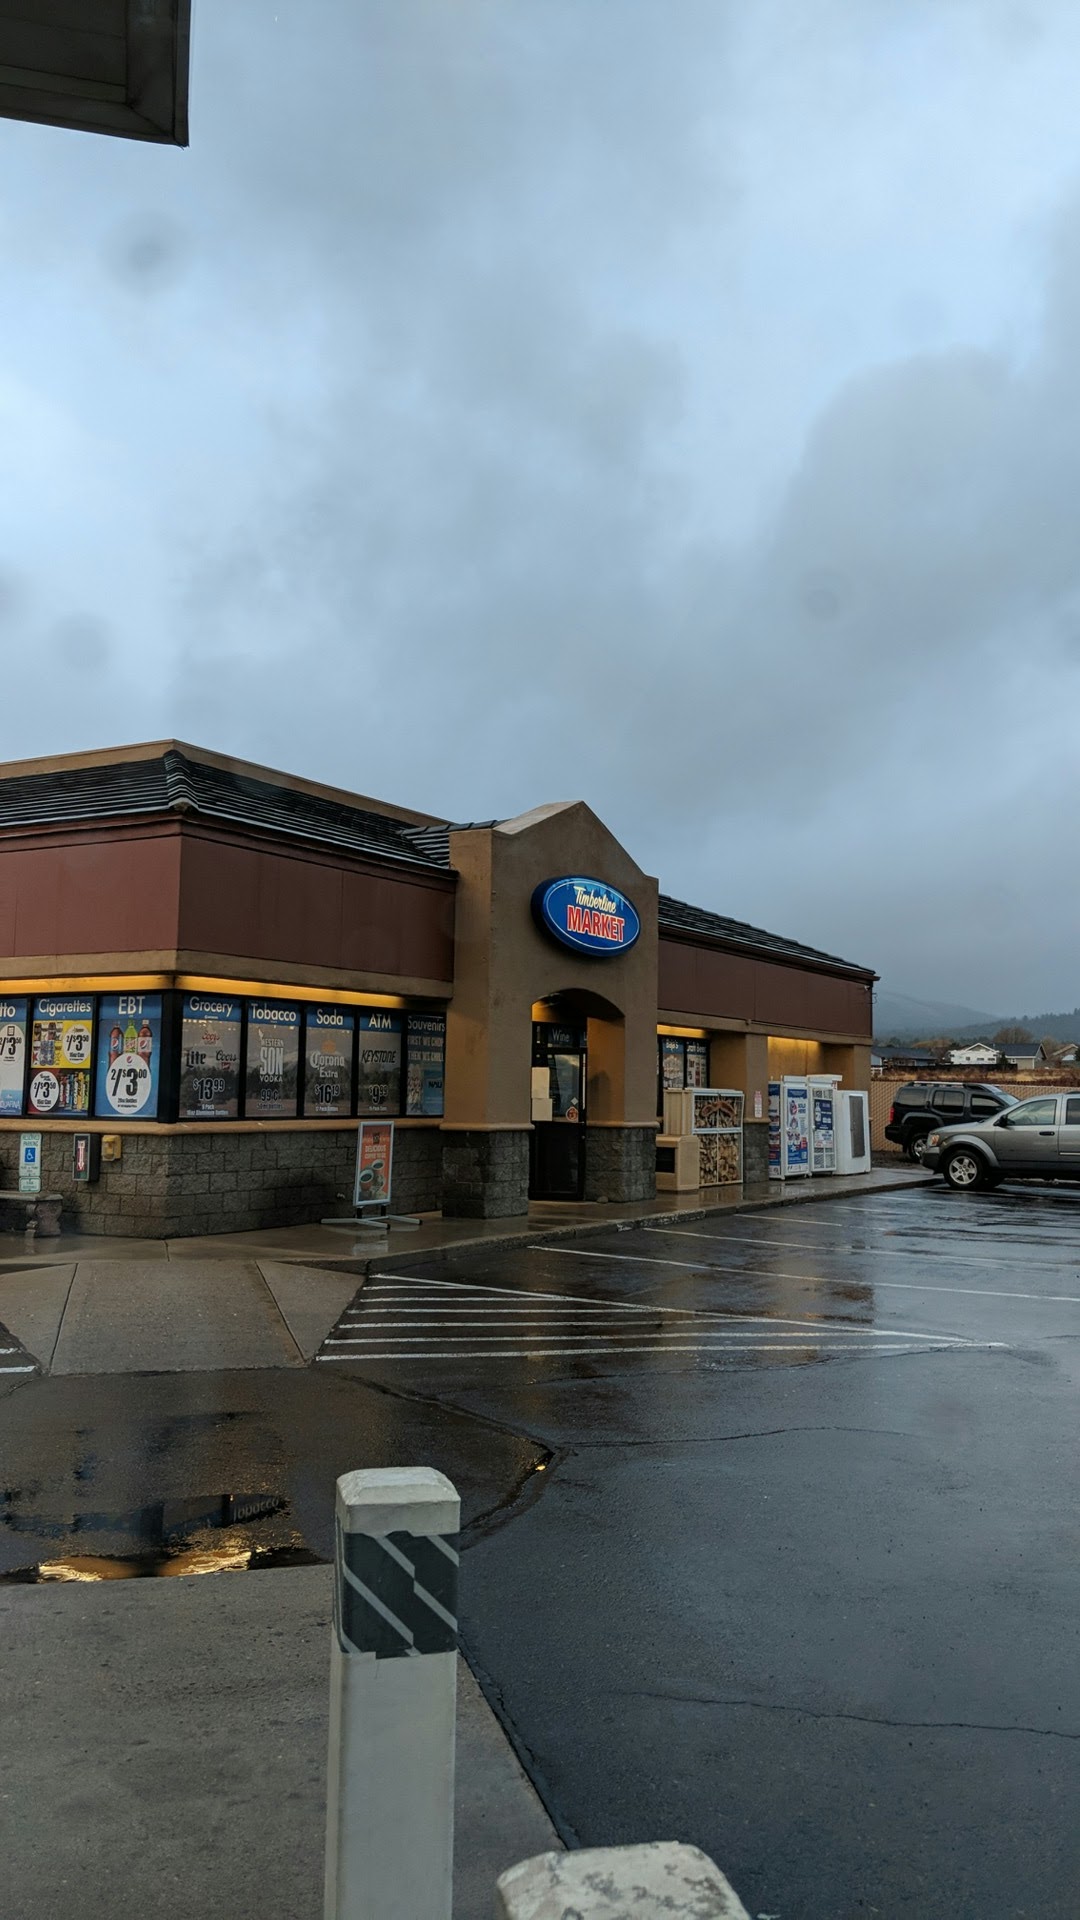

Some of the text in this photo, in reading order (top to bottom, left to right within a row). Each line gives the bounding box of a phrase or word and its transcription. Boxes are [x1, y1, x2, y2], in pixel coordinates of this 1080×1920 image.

[573, 886, 617, 914] Timberline
[567, 905, 625, 942] MARKET
[38, 999, 92, 1017] Cigarettes
[118, 996, 146, 1015] EBT
[189, 996, 233, 1018] Grocery
[251, 1003, 297, 1022] Tobacco
[316, 1009, 344, 1026] Soda
[368, 1013, 392, 1029] ATM
[407, 1015, 446, 1032] Souvenirs
[552, 1029, 570, 1042] Wine
[184, 1046, 206, 1069] Lite
[215, 1049, 237, 1062] Coors
[260, 1047, 284, 1075] SON
[309, 1052, 345, 1069] Corona
[361, 1049, 397, 1064] KEYSTONE
[260, 1075, 283, 1084] VODKA
[320, 1067, 339, 1078] Extra
